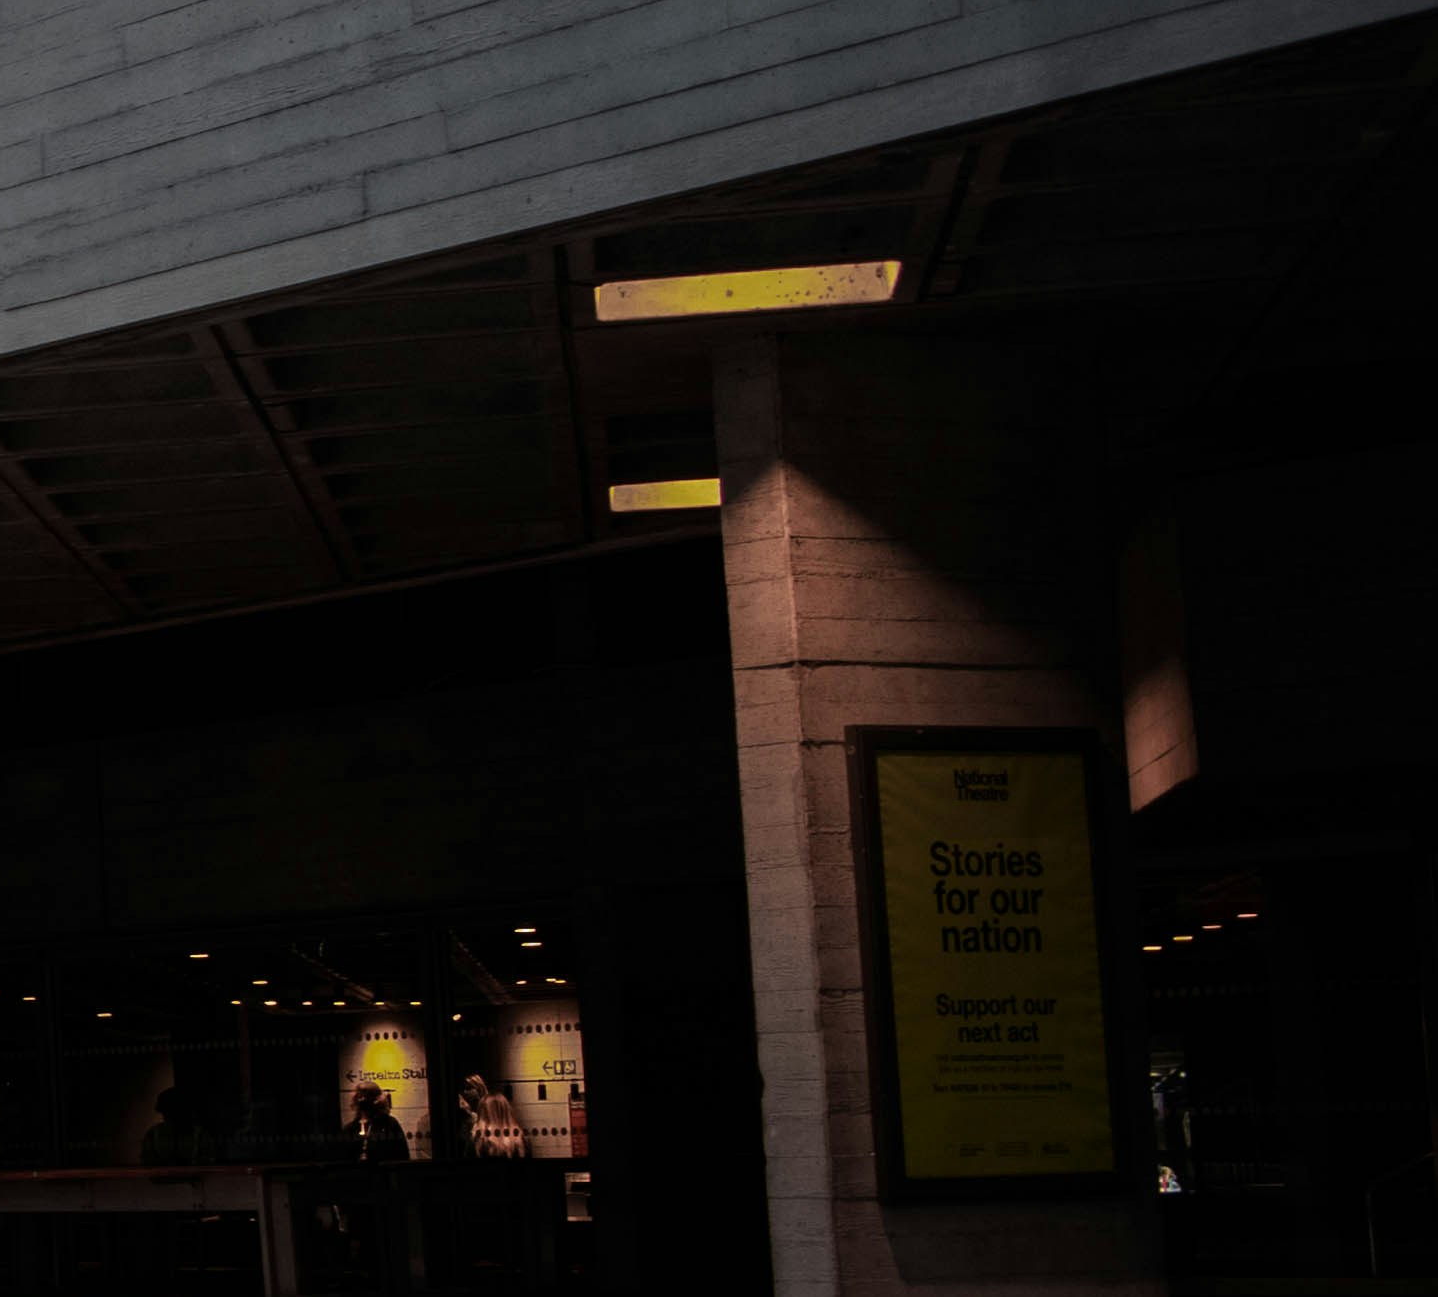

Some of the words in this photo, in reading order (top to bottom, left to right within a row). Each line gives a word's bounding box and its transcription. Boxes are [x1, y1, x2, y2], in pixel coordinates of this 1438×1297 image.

[954, 768, 1008, 788] National
[956, 788, 1008, 801] Theatre
[930, 841, 1043, 877] Stories
[935, 880, 980, 914] for
[991, 889, 1043, 914] our
[943, 918, 1042, 952] nation
[935, 993, 1017, 1020] Support
[1024, 998, 1057, 1015] our
[958, 1022, 1000, 1042] next
[1008, 1022, 1039, 1042] act
